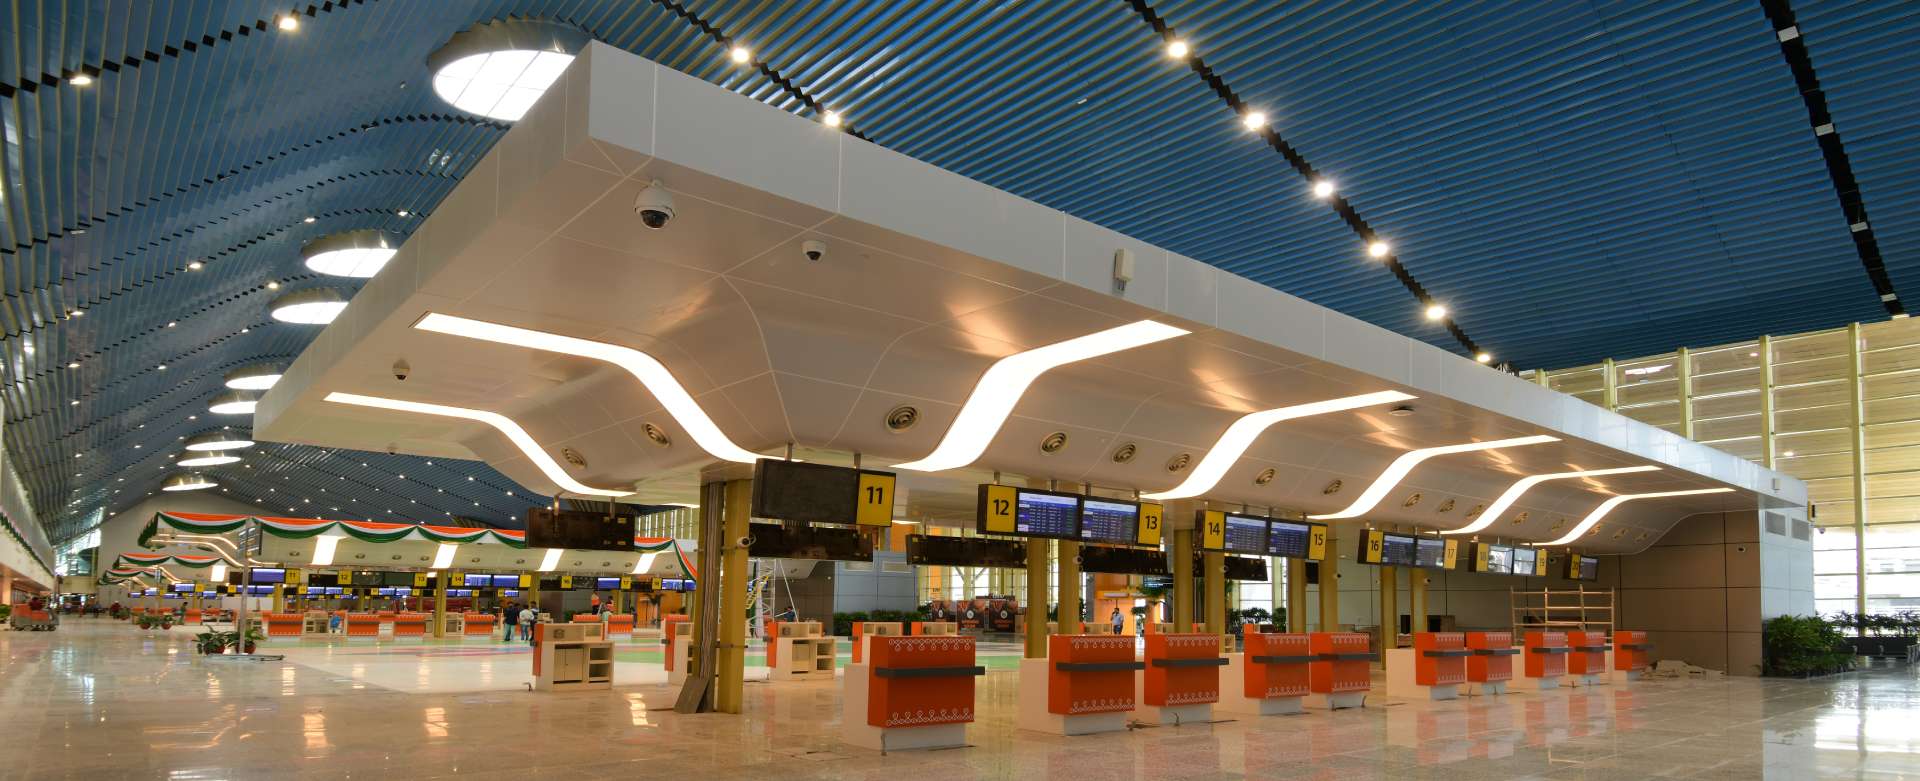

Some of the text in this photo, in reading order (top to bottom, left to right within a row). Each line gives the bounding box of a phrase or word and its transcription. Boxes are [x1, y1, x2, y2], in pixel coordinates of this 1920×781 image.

[866, 486, 883, 505] 11
[993, 498, 1009, 516] 12
[1145, 515, 1158, 530] 13
[1208, 522, 1220, 536] 14
[1314, 533, 1323, 546] 15
[1371, 540, 1379, 551] 16
[1447, 548, 1456, 558] 17
